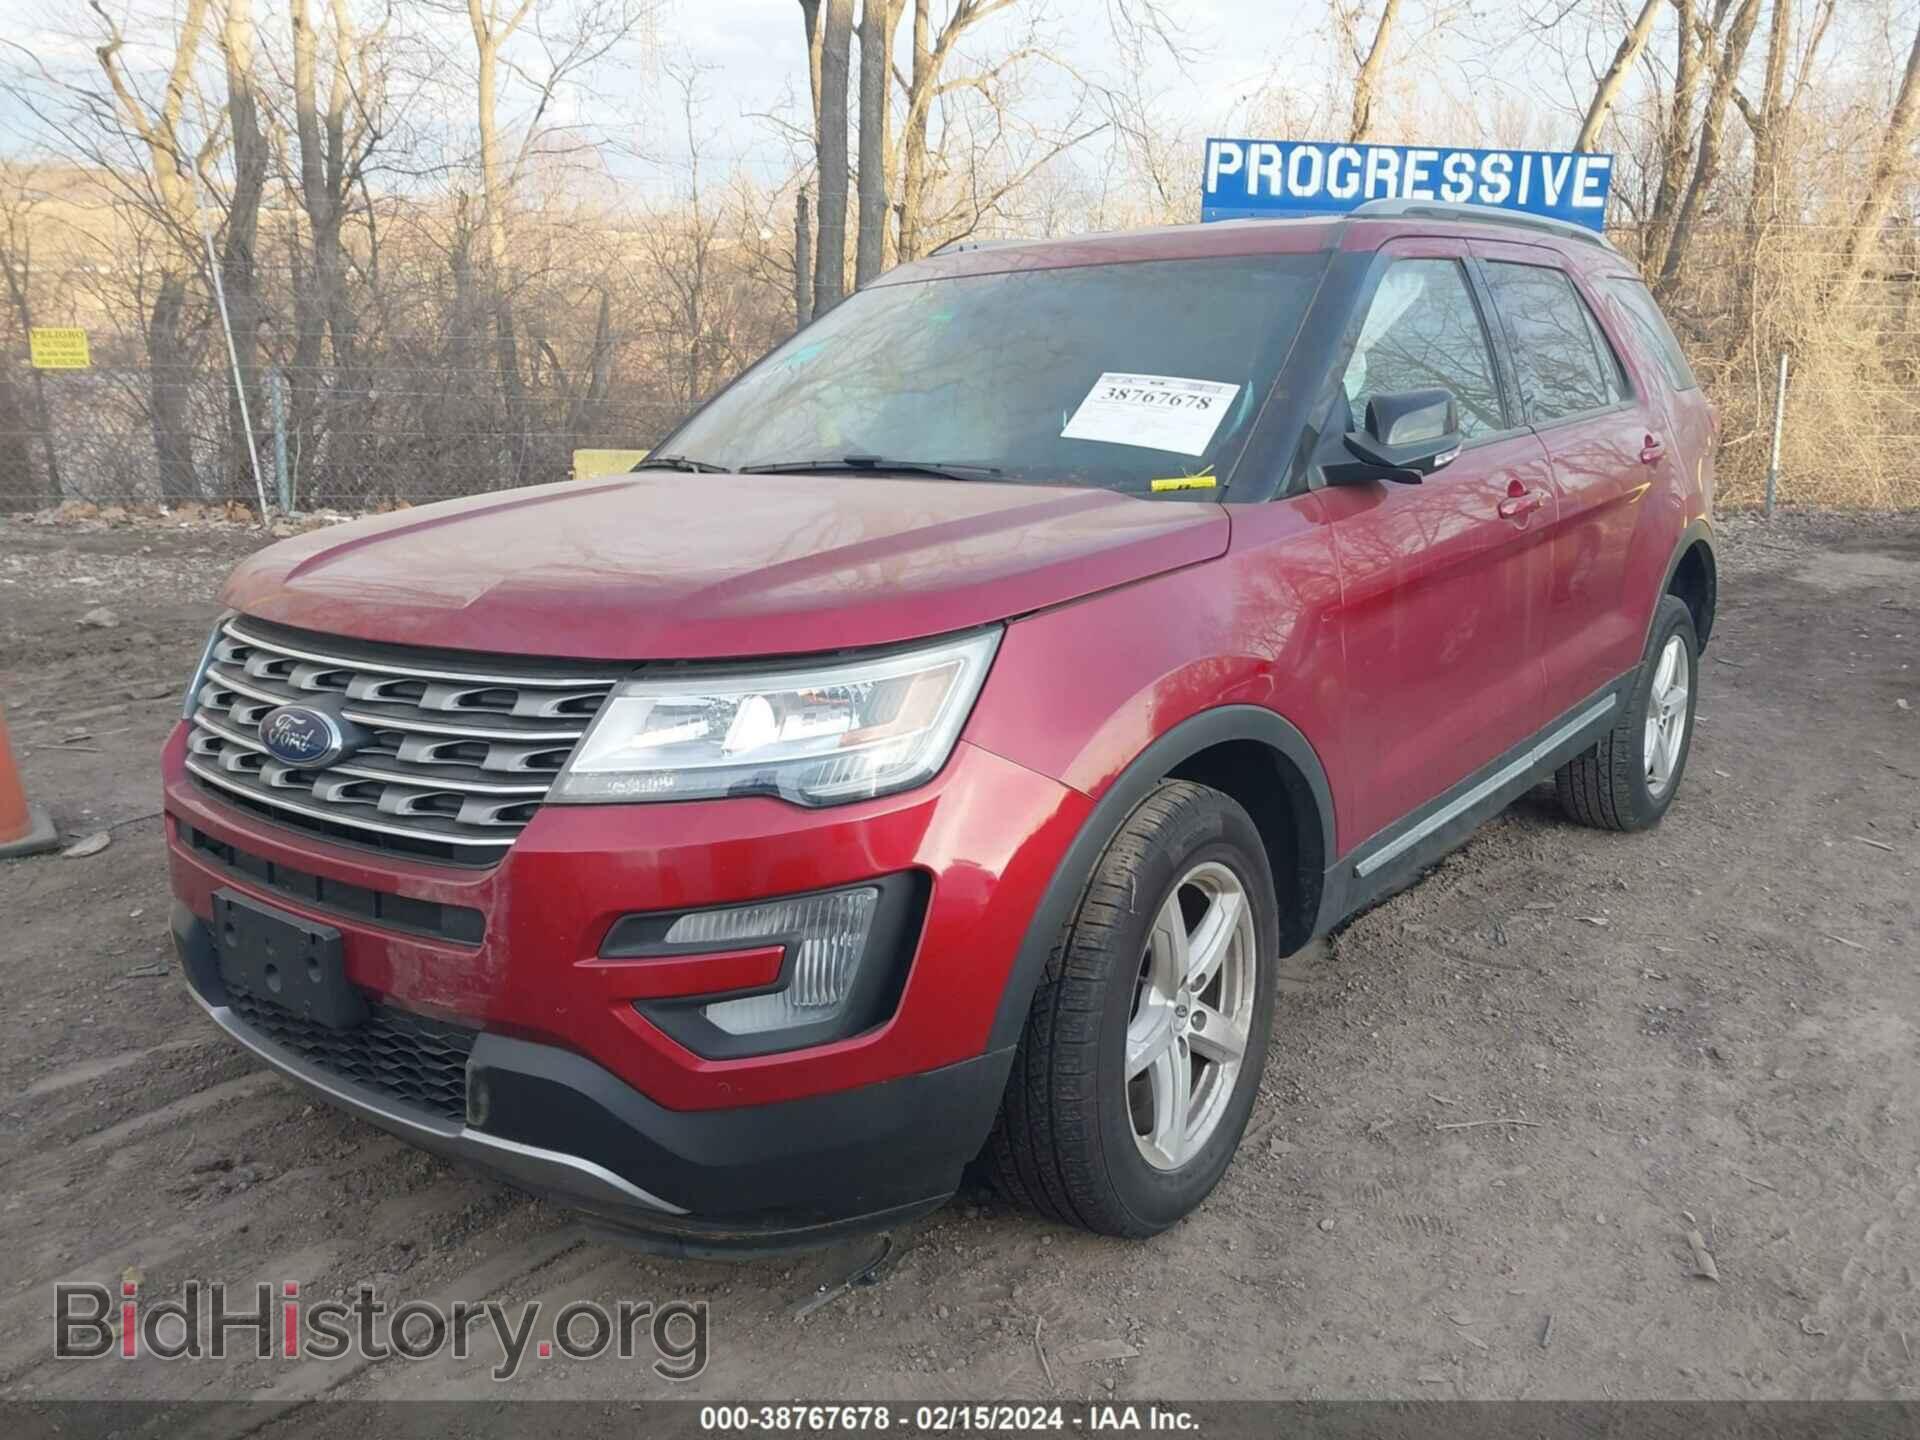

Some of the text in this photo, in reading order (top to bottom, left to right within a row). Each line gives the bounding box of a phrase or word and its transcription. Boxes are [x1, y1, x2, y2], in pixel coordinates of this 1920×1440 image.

[1206, 141, 1610, 208] PROGRESSIVE
[1100, 387, 1213, 410] 38767678
[268, 713, 315, 753] Ford
